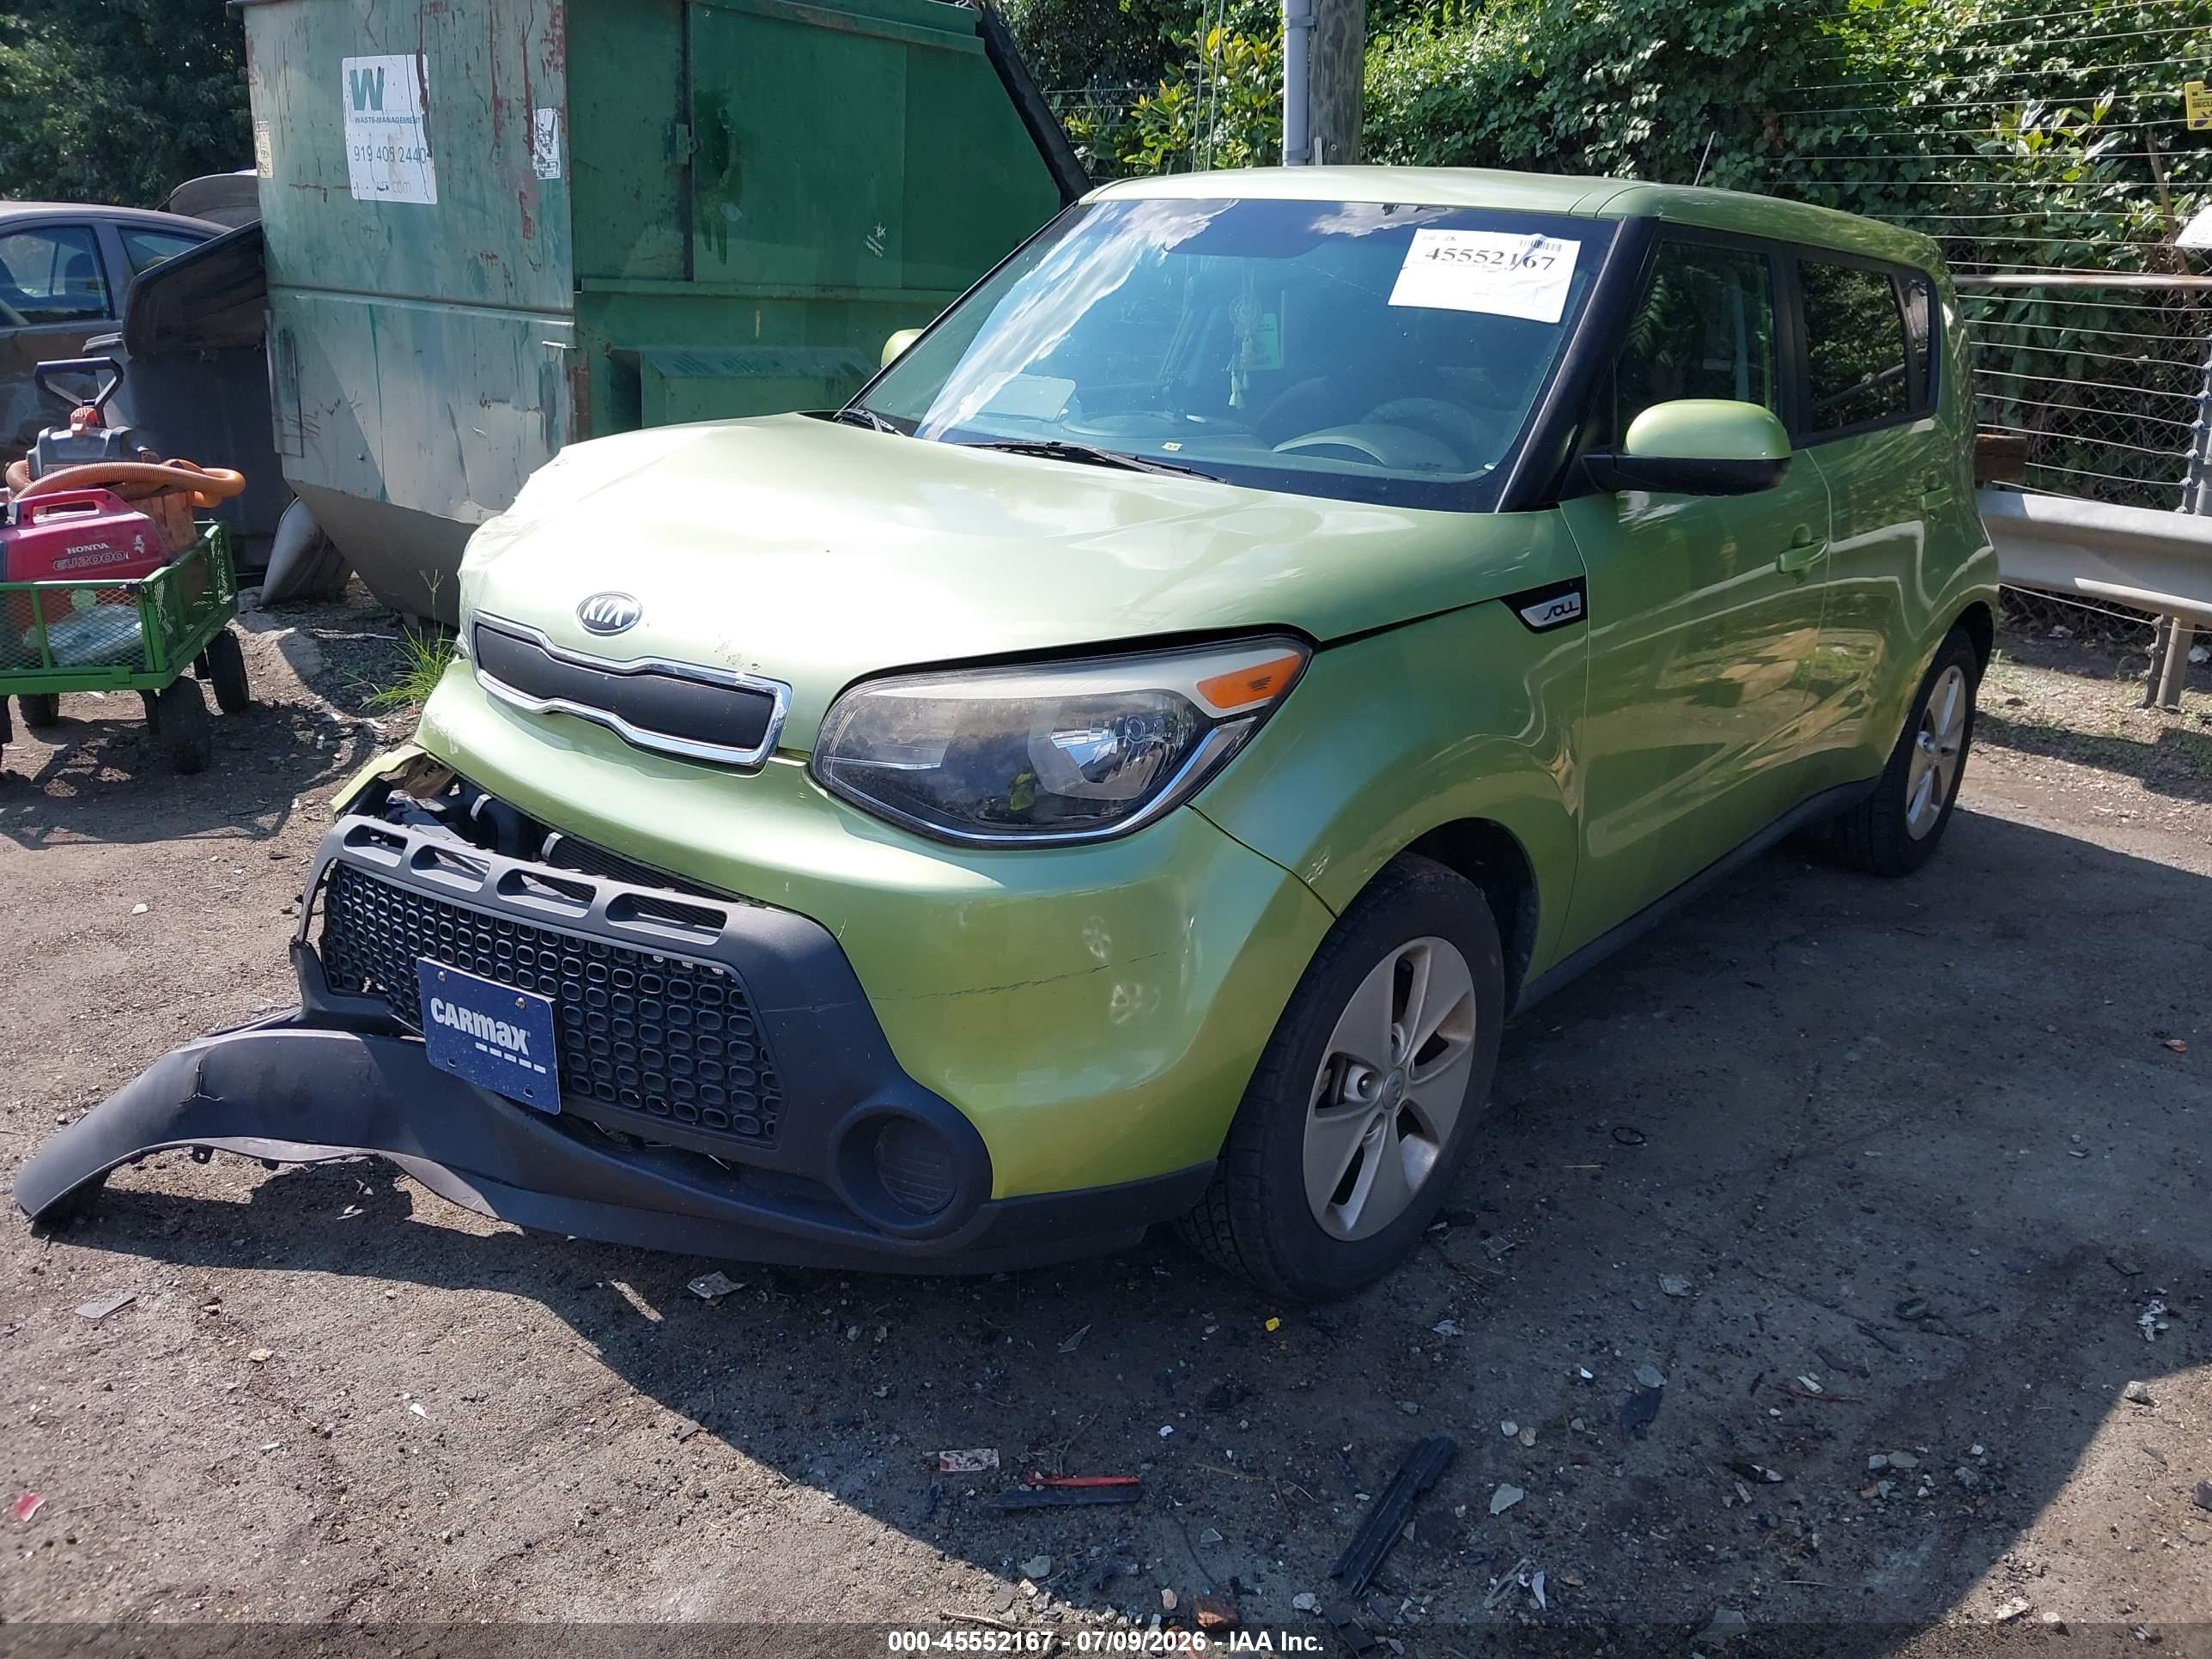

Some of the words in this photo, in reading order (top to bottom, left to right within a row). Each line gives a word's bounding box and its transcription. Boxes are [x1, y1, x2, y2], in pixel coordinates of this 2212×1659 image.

[354, 145, 373, 162] 919
[1425, 247, 1556, 271] 45552167
[65, 543, 110, 555] HONDA
